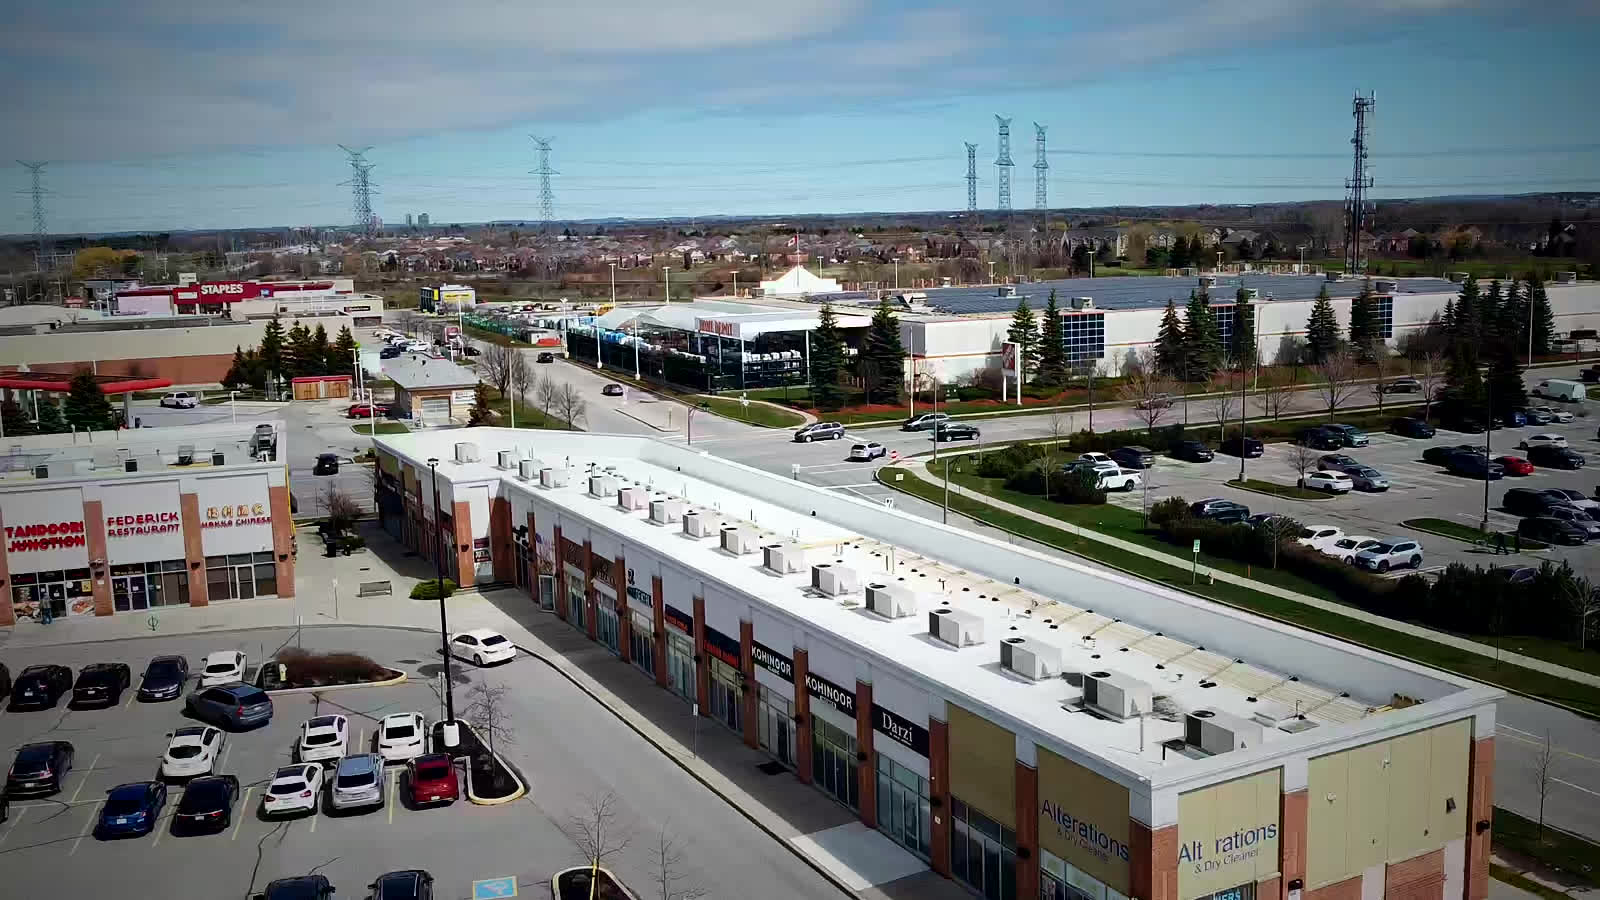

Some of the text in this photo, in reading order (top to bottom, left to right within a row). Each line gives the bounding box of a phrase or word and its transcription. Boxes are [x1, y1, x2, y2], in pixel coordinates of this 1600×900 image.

[201, 283, 244, 295] STAPLES
[107, 511, 179, 527] FEDERICK
[4, 520, 85, 539] TANDOORI
[108, 523, 180, 537] RESTAURANT
[7, 535, 86, 553] JUNCTION
[751, 644, 792, 677] KOHINOOR
[804, 673, 854, 711] KOHINOOR
[882, 711, 913, 743] Darzi
[1041, 799, 1129, 862] Alterations
[1194, 863, 1202, 874] &
[1204, 857, 1221, 873] Dry
